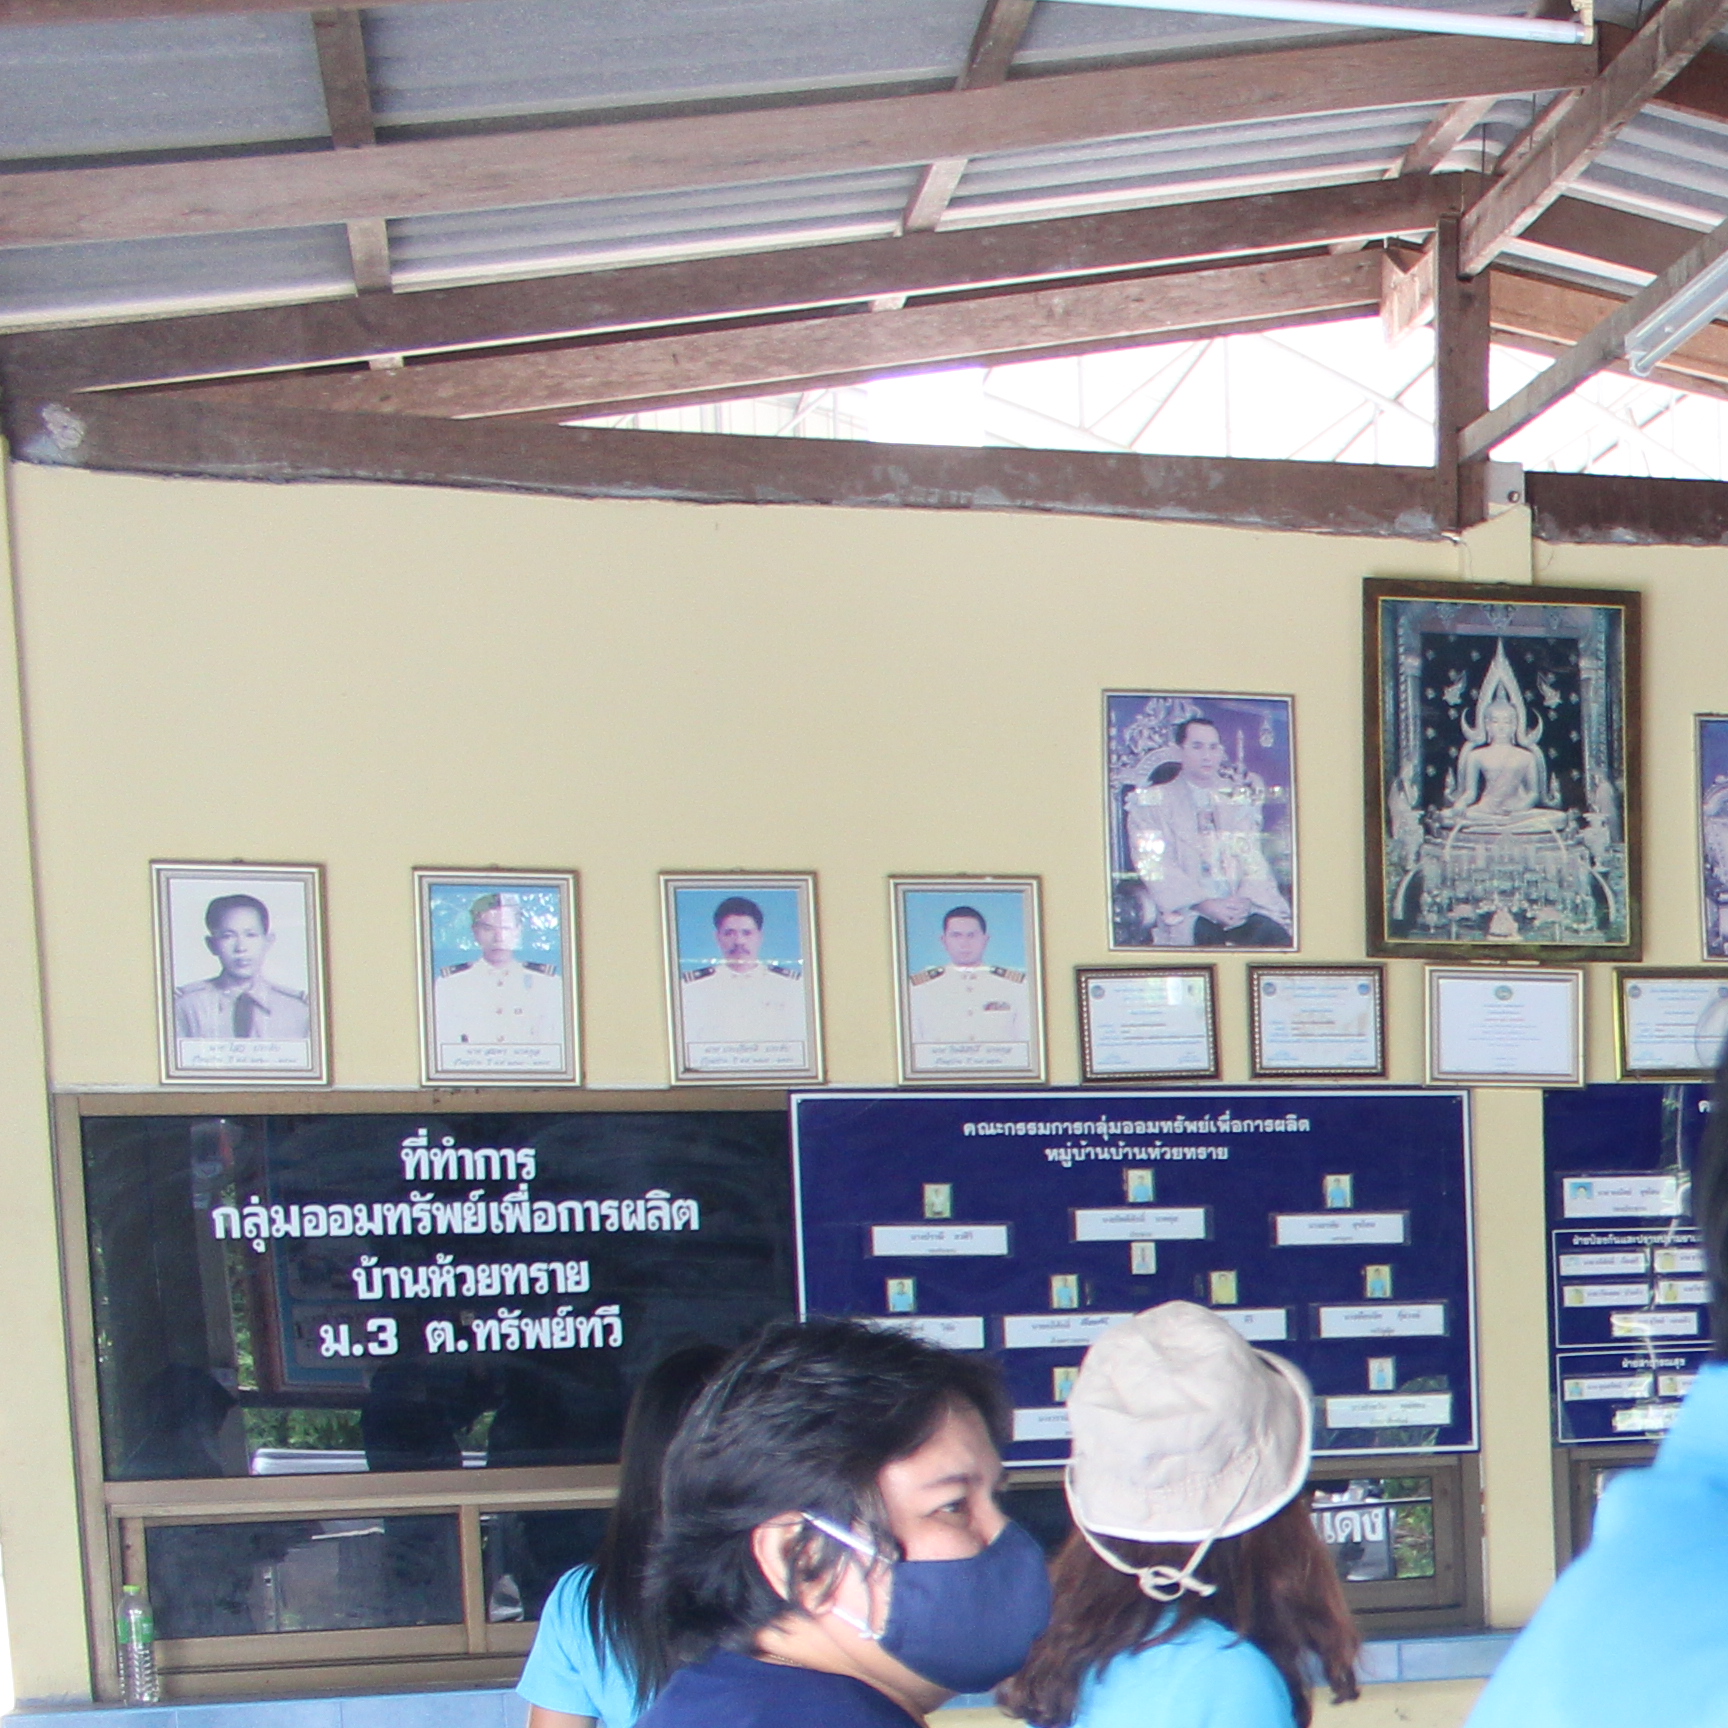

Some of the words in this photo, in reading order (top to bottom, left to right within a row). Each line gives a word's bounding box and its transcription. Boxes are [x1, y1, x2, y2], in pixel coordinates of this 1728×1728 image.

[963, 1111, 1310, 1140] คณะกรรมการกลุ่มออมทรัพย์เพื่อการผลิต
[401, 1128, 537, 1181] ที่ทำการ
[211, 1183, 700, 1253] กลุ่มออมทรัพย์เพื่อการผลิต
[352, 1253, 589, 1300] บ้านห้วยทราย
[320, 1317, 398, 1358] ม.3
[425, 1305, 623, 1353] ต.ทรัพย์ทวี
